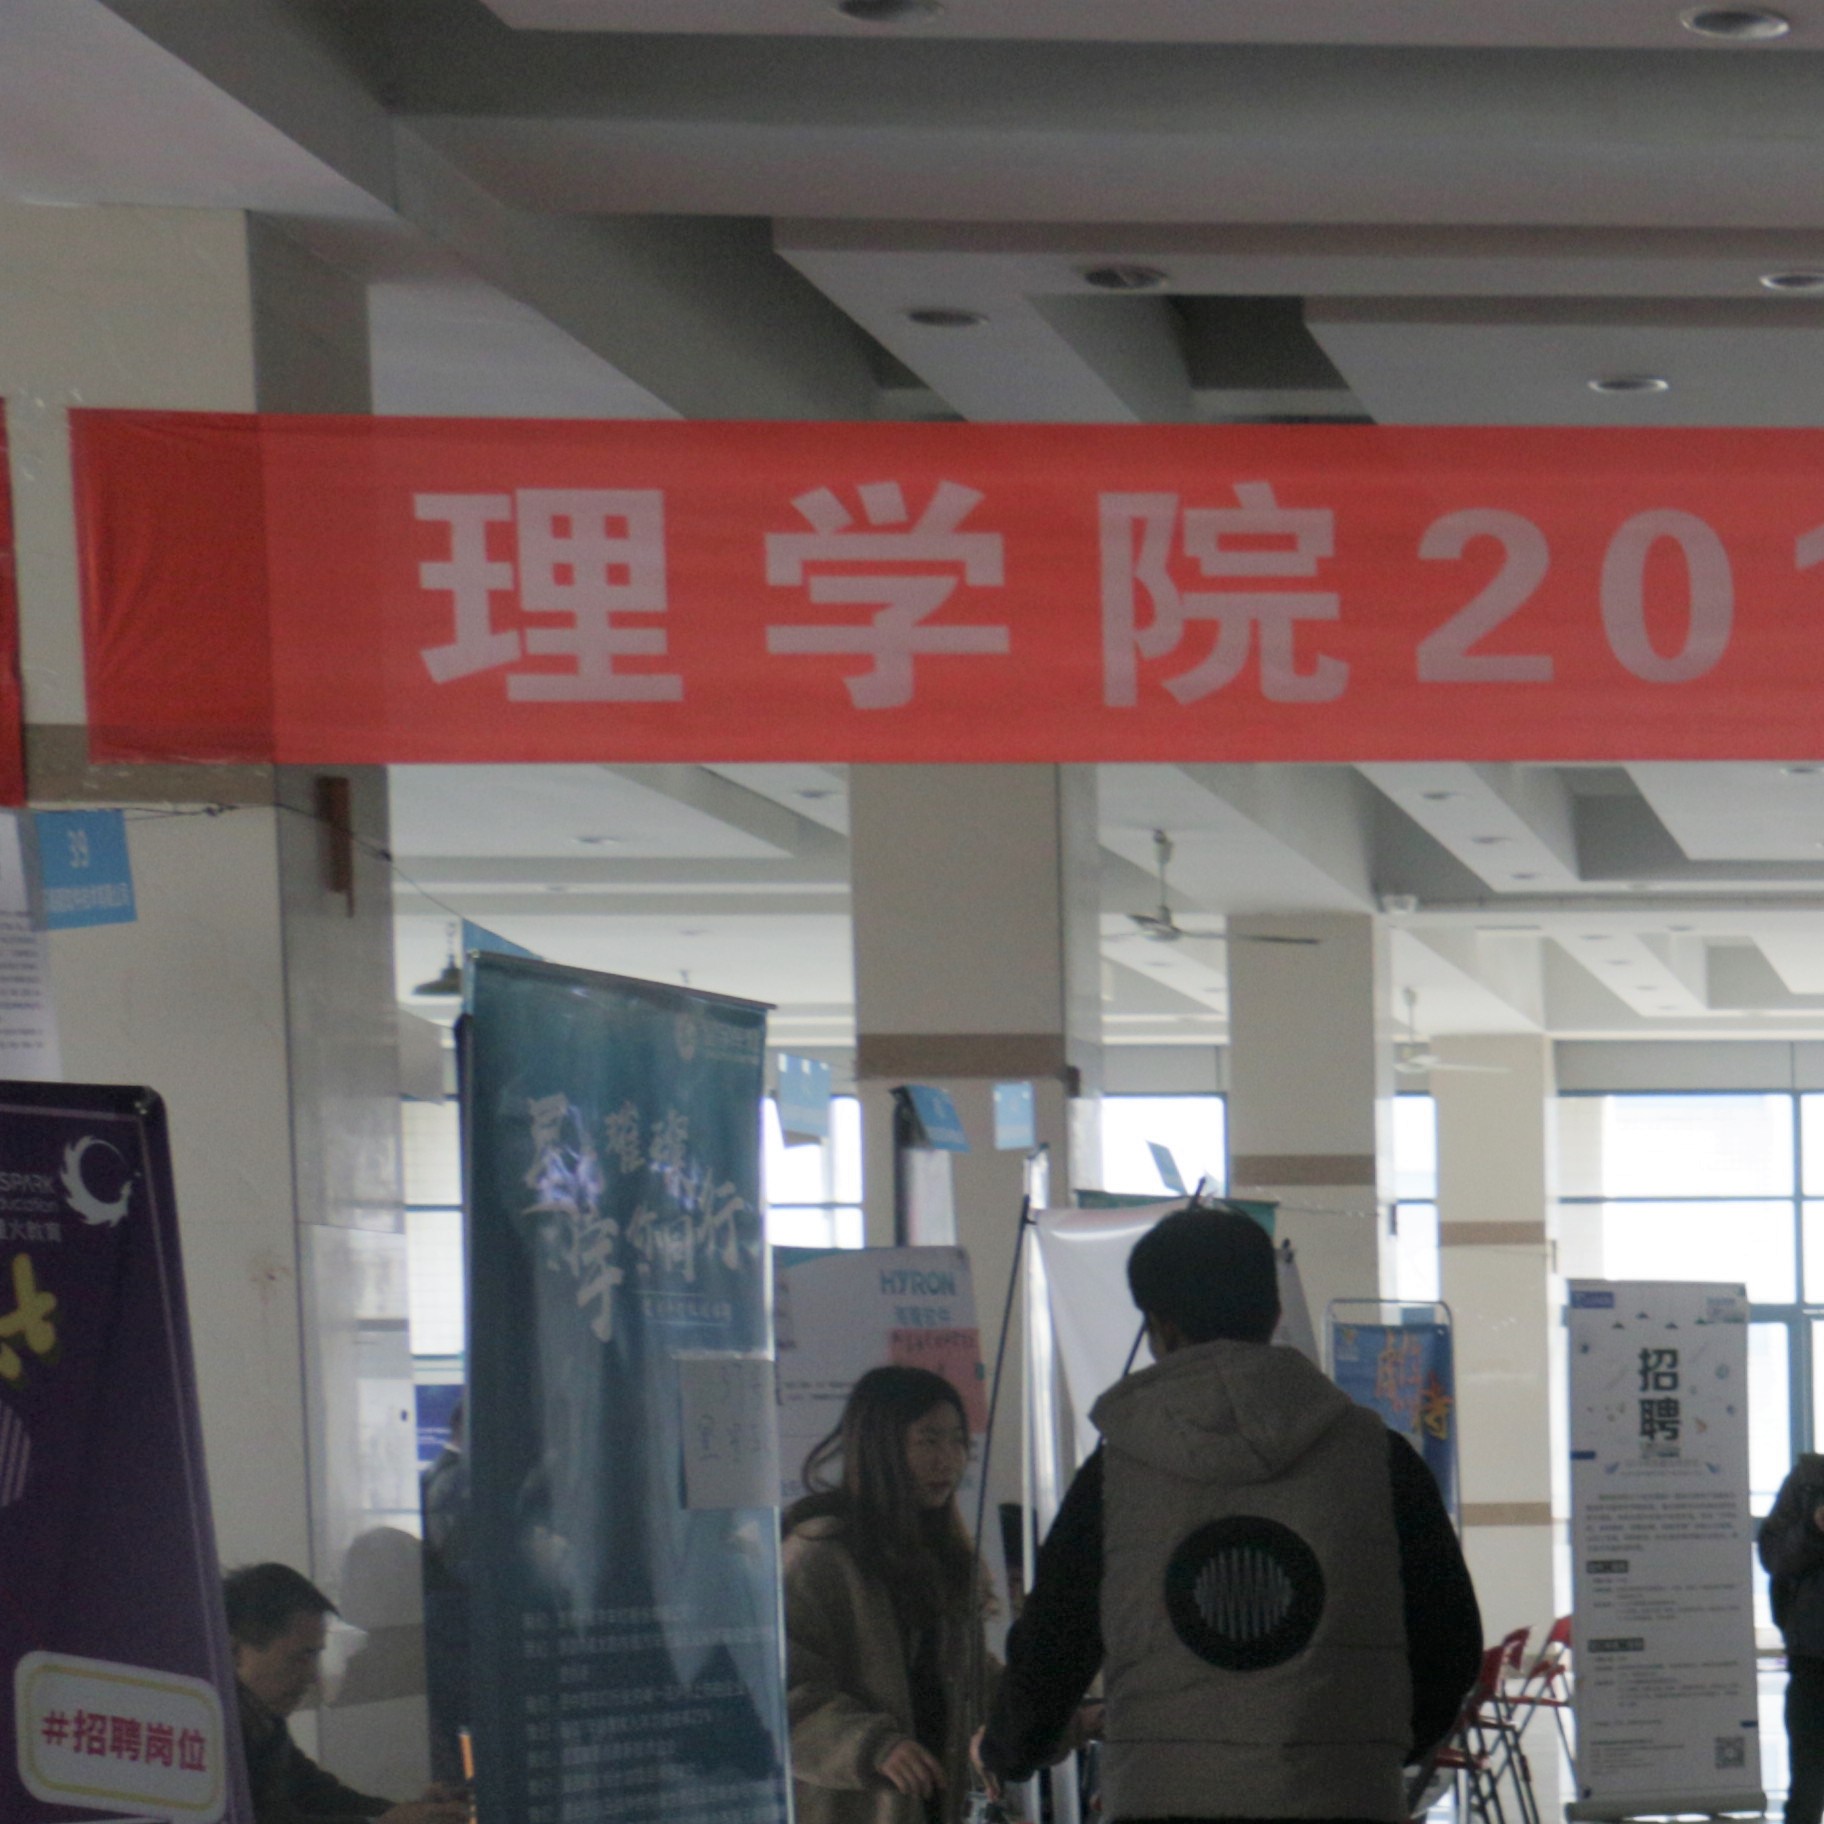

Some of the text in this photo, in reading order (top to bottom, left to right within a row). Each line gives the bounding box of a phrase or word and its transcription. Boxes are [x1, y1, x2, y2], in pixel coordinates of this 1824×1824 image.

[1637, 1346, 1682, 1442] 招聘
[41, 1705, 210, 1775] #招聘岗位
